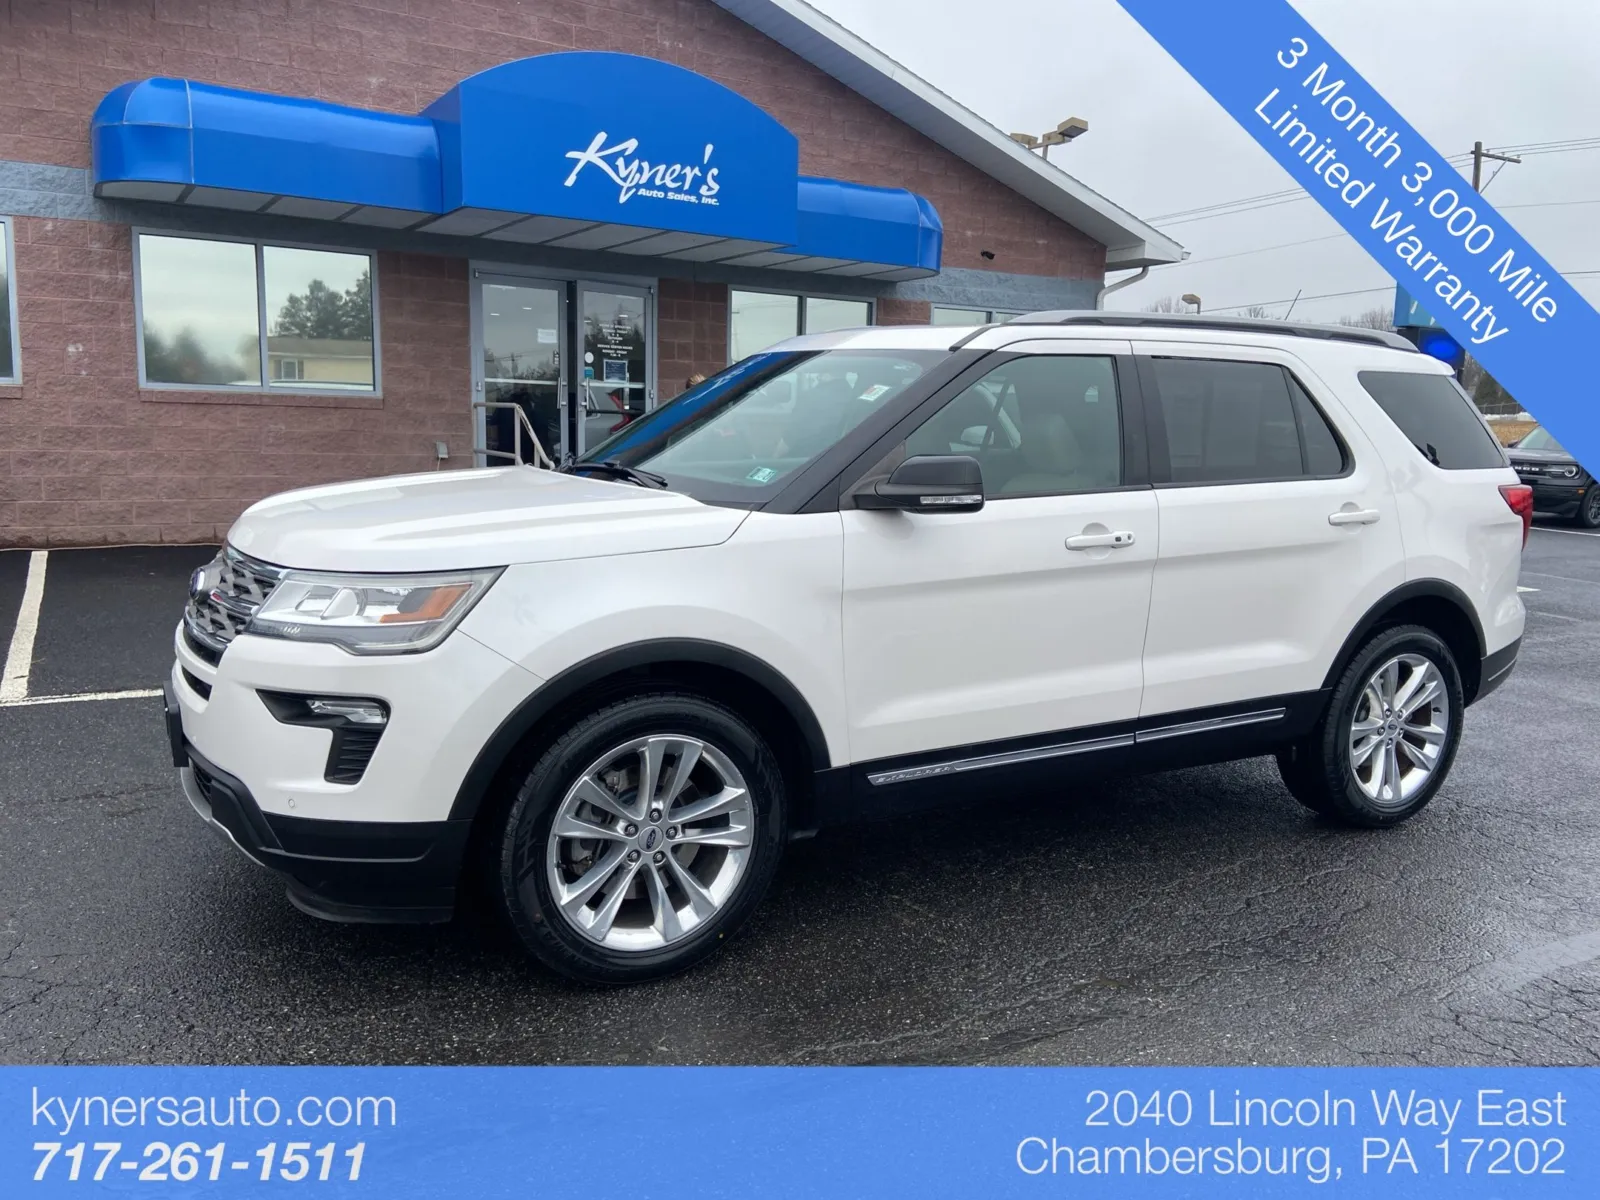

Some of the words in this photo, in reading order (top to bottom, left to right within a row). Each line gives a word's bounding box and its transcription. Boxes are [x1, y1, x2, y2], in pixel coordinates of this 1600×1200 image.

[564, 131, 720, 204] Kyner's
[637, 188, 665, 198] Auto
[666, 191, 699, 204] Sales,
[701, 196, 719, 205] Inc.
